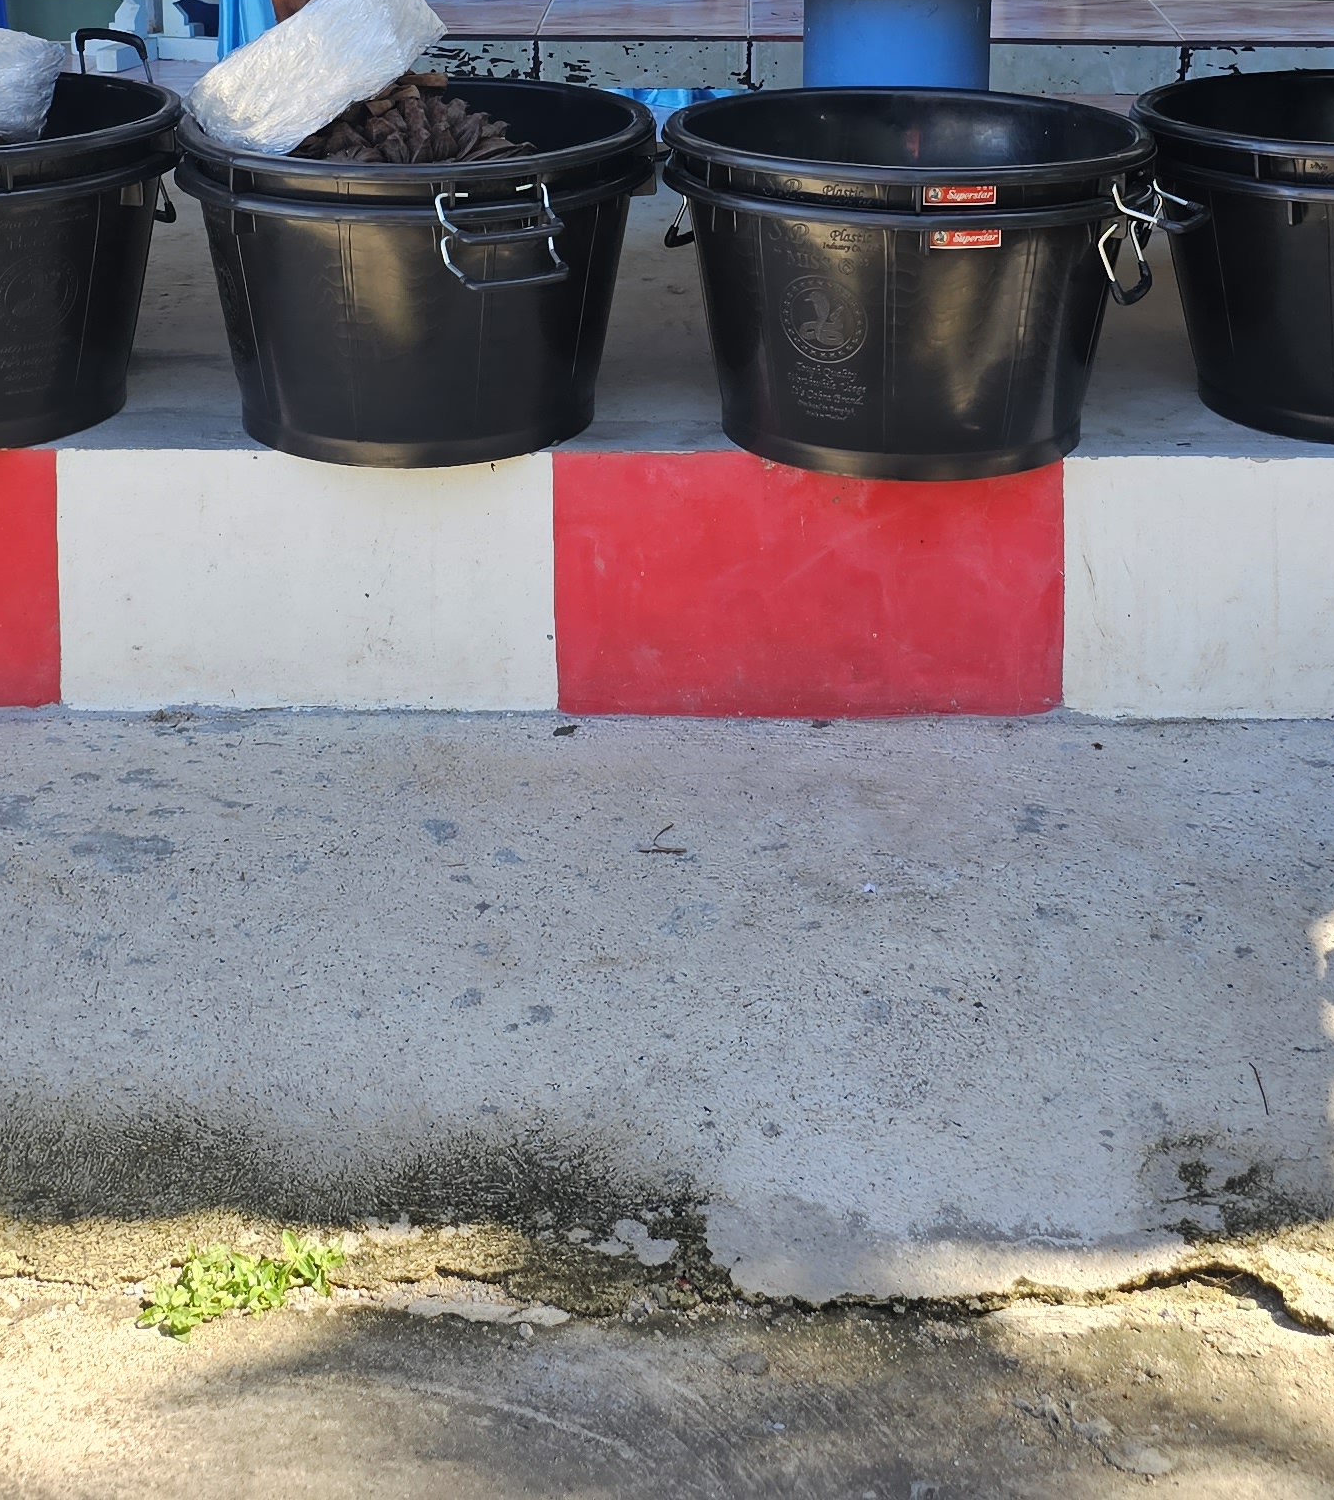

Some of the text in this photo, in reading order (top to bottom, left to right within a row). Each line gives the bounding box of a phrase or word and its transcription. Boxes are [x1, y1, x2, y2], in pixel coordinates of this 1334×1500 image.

[947, 190, 993, 201] Superstar
[830, 229, 873, 243] Plastic
[953, 232, 998, 244] Superstar
